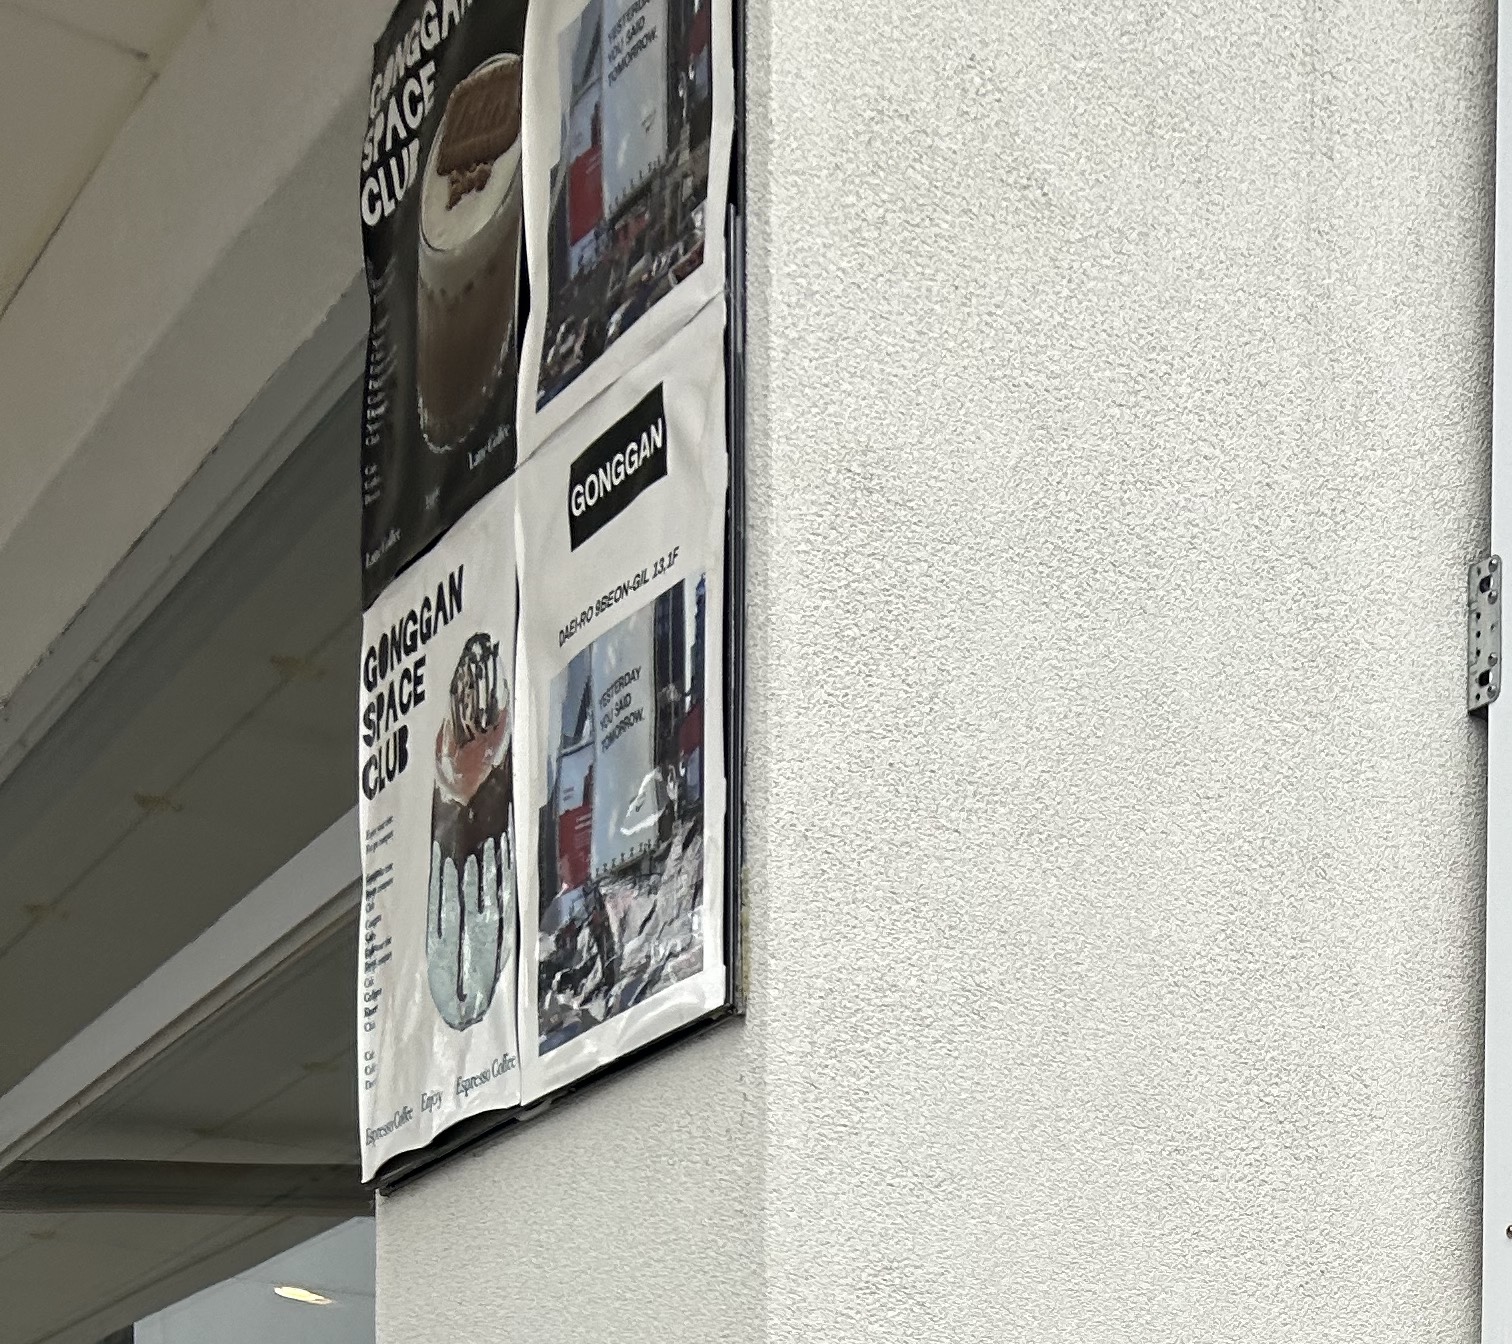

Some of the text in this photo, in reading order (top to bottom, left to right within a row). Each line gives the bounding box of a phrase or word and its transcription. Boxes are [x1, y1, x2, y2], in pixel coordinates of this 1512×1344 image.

[361, 60, 436, 172] SPACE
[571, 417, 663, 517] GONGGAN
[363, 564, 464, 693] GONGGAN
[362, 654, 426, 748] SPACE
[361, 724, 410, 801] CLUB
[456, 1069, 491, 1097] Espresso
